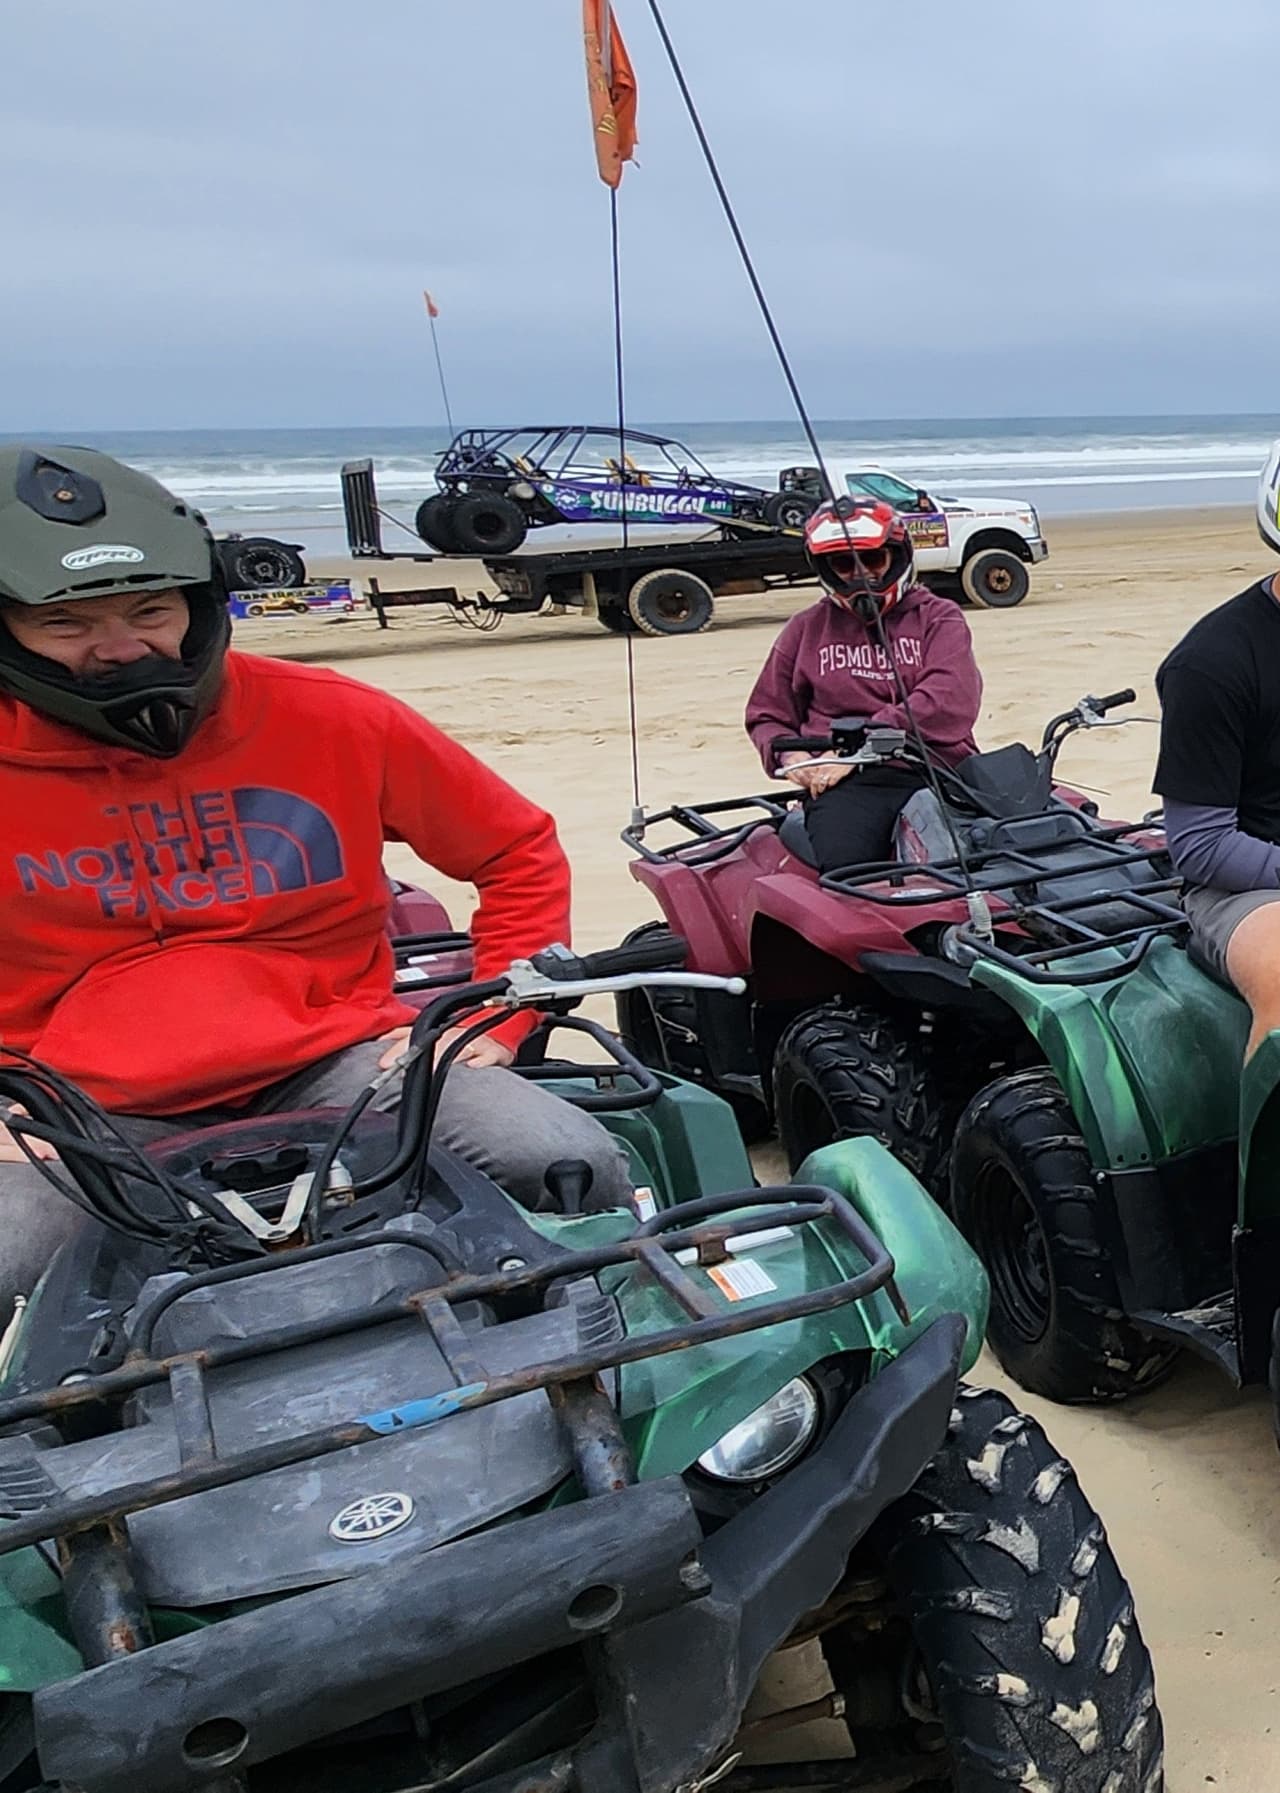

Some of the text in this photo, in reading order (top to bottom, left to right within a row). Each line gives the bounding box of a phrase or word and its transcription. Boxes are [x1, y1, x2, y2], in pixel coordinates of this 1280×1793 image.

[590, 490, 706, 514] SUNBUGGY
[819, 644, 873, 676] PISMO
[103, 790, 231, 838] THE
[15, 828, 245, 893] NORTH
[97, 865, 250, 919] FACE
